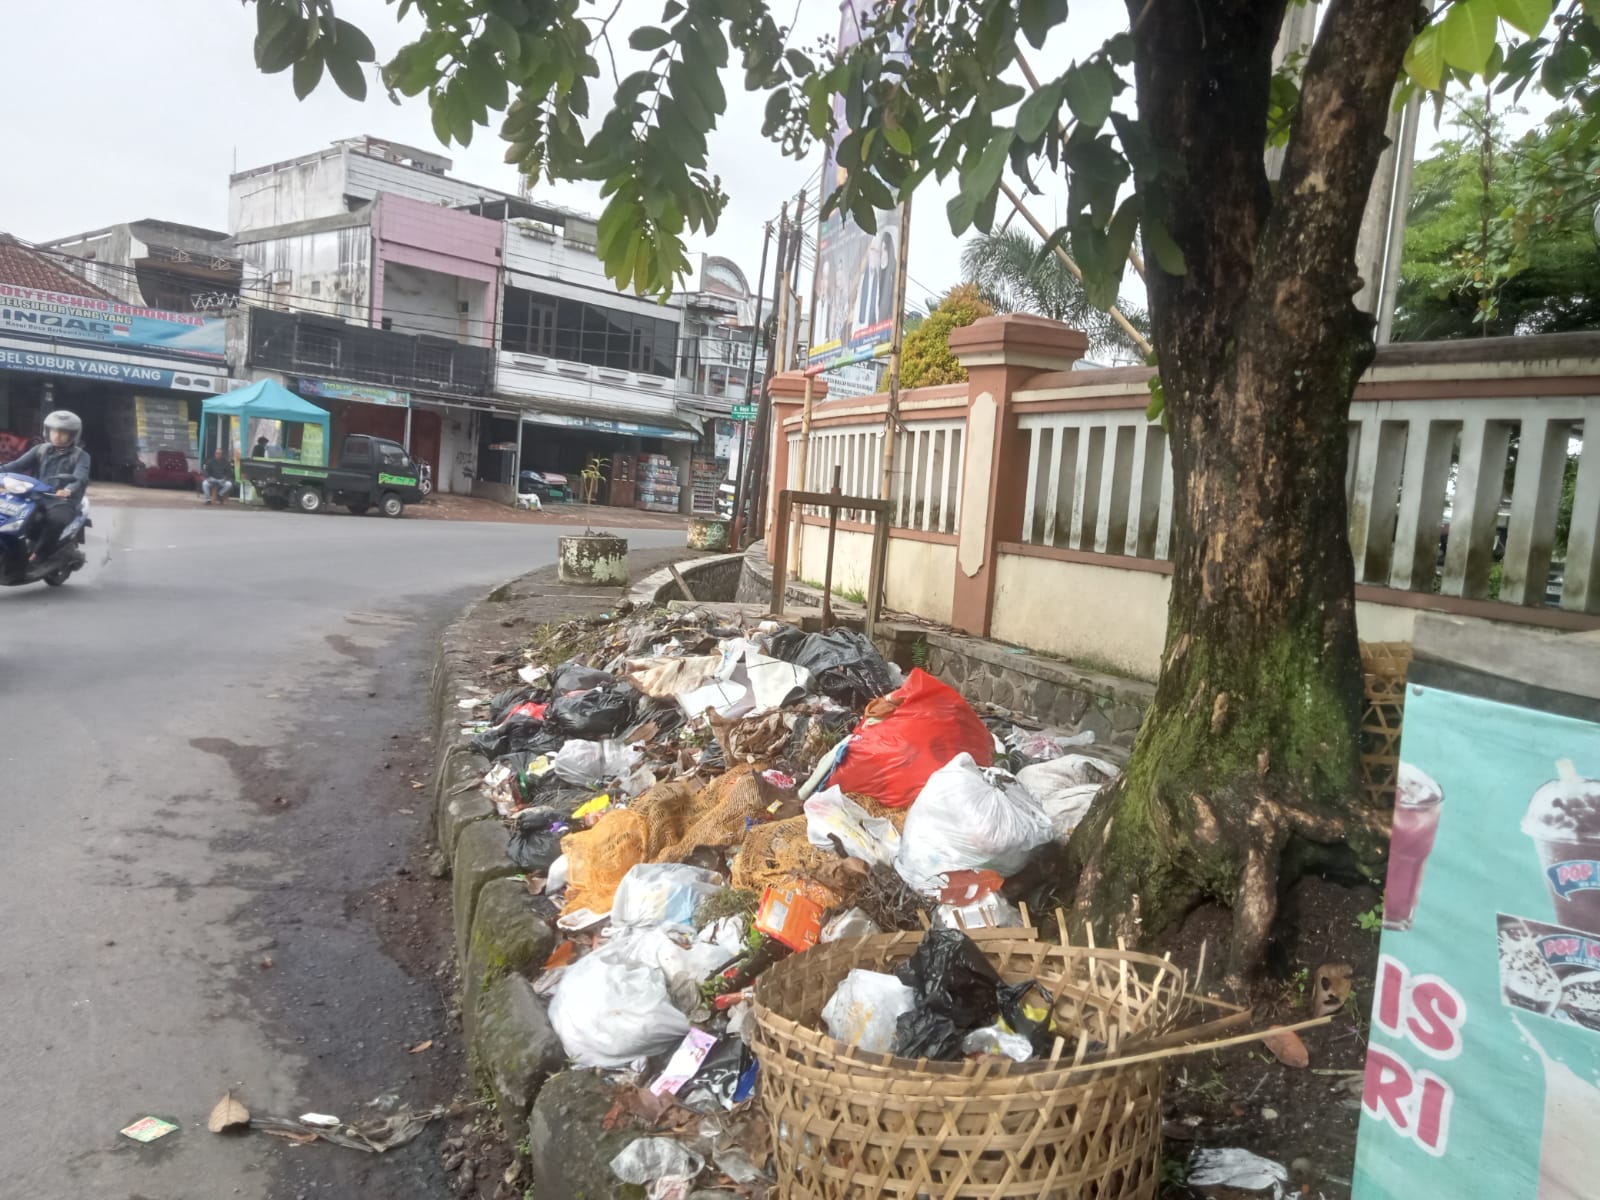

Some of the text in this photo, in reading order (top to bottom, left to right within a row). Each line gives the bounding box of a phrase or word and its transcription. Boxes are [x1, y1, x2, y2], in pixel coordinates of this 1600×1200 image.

[0, 285, 205, 327] OLYTECHNO INDONESIA
[22, 299, 66, 315] SUBUR
[68, 306, 100, 319] YANG
[102, 312, 132, 325] YANG
[26, 354, 75, 371] SUBUR
[78, 360, 119, 376] YANG
[123, 366, 161, 381] YANG
[1557, 864, 1592, 885] POP
[1543, 938, 1579, 959] POP
